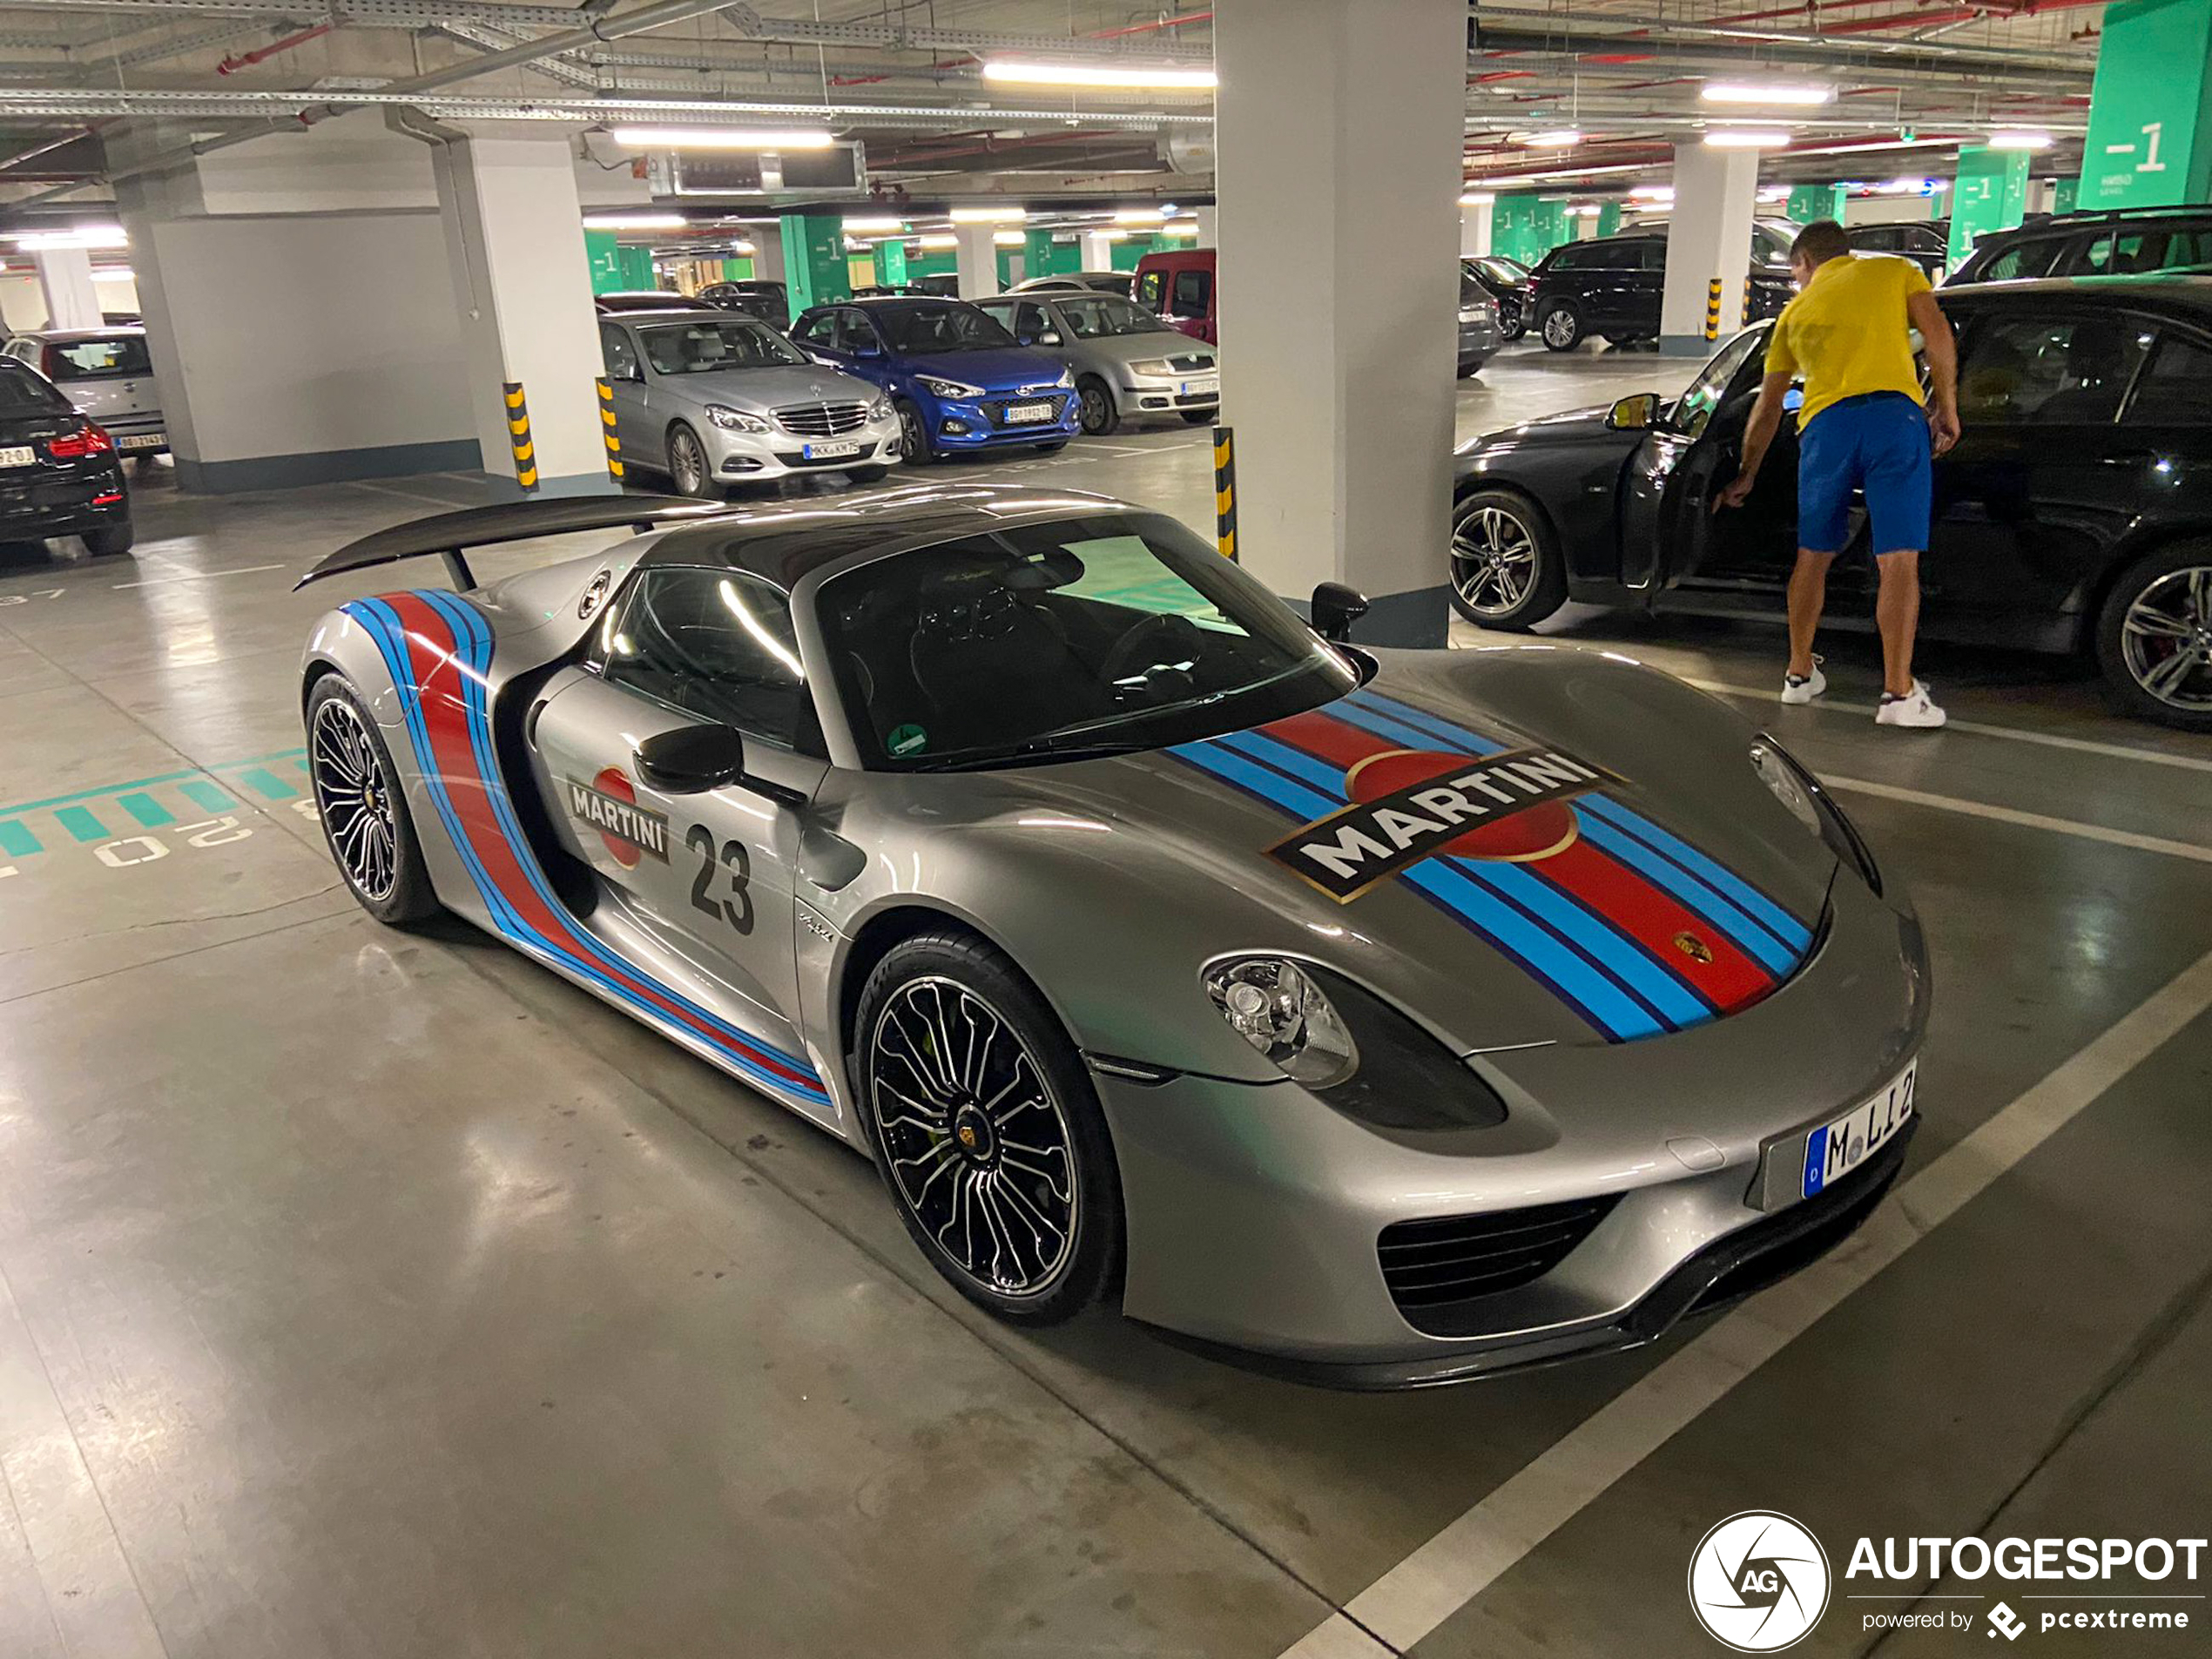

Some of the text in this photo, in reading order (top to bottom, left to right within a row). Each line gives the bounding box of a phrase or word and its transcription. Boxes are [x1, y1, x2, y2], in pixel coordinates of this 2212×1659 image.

[2107, 123, 2166, 172] -1
[1966, 178, 1992, 199] -1
[1496, 211, 1512, 229] -1
[593, 252, 617, 272] -1
[816, 237, 840, 260] -1
[572, 786, 664, 853] MARTINI
[1299, 753, 1599, 880] MARTINI
[685, 824, 754, 936] 23
